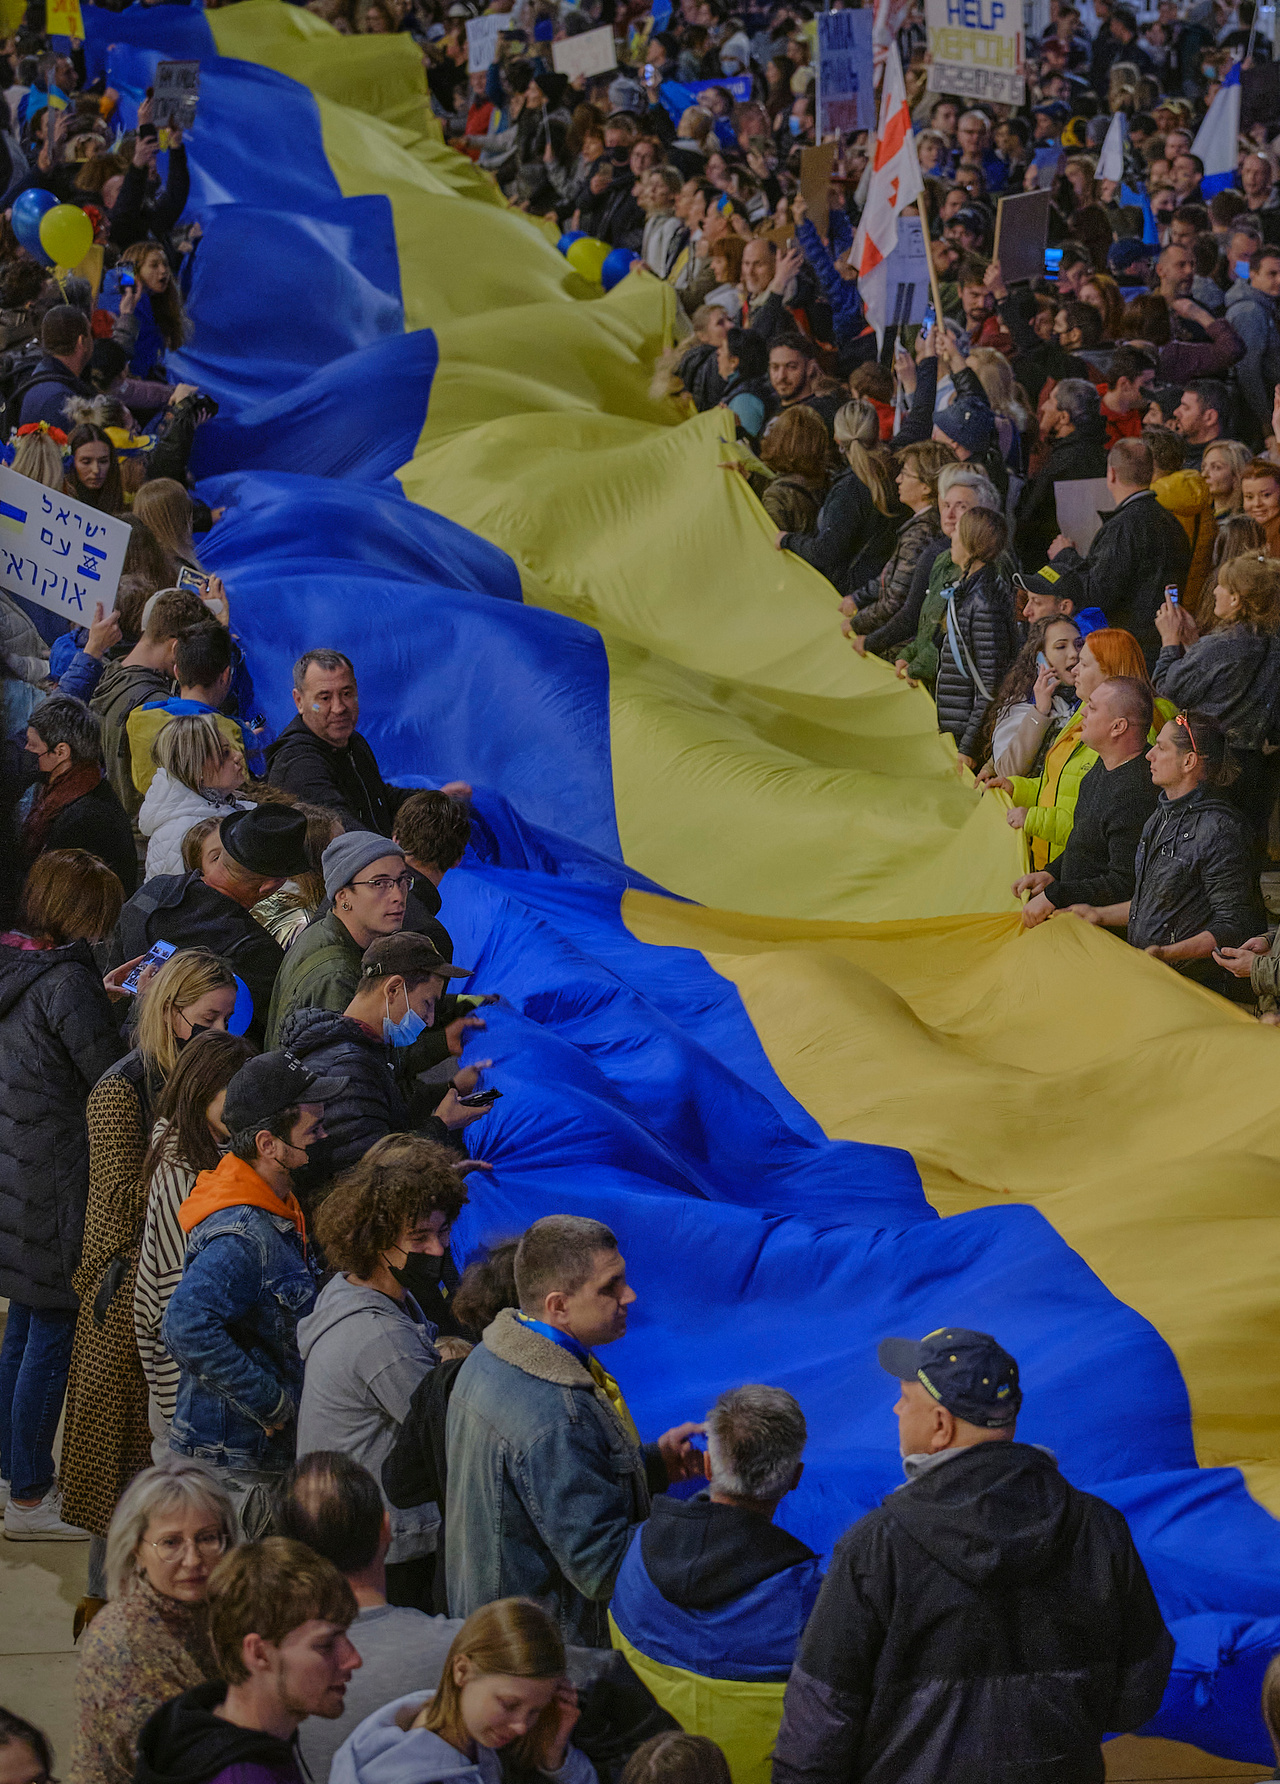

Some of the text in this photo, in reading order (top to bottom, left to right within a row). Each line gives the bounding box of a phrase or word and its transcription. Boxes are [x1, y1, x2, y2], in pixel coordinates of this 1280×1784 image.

[947, 0, 1005, 30] HELP
[41, 494, 106, 537] ישראל
[40, 527, 71, 556] עם
[917, 1369, 942, 1400] UKRAINE
